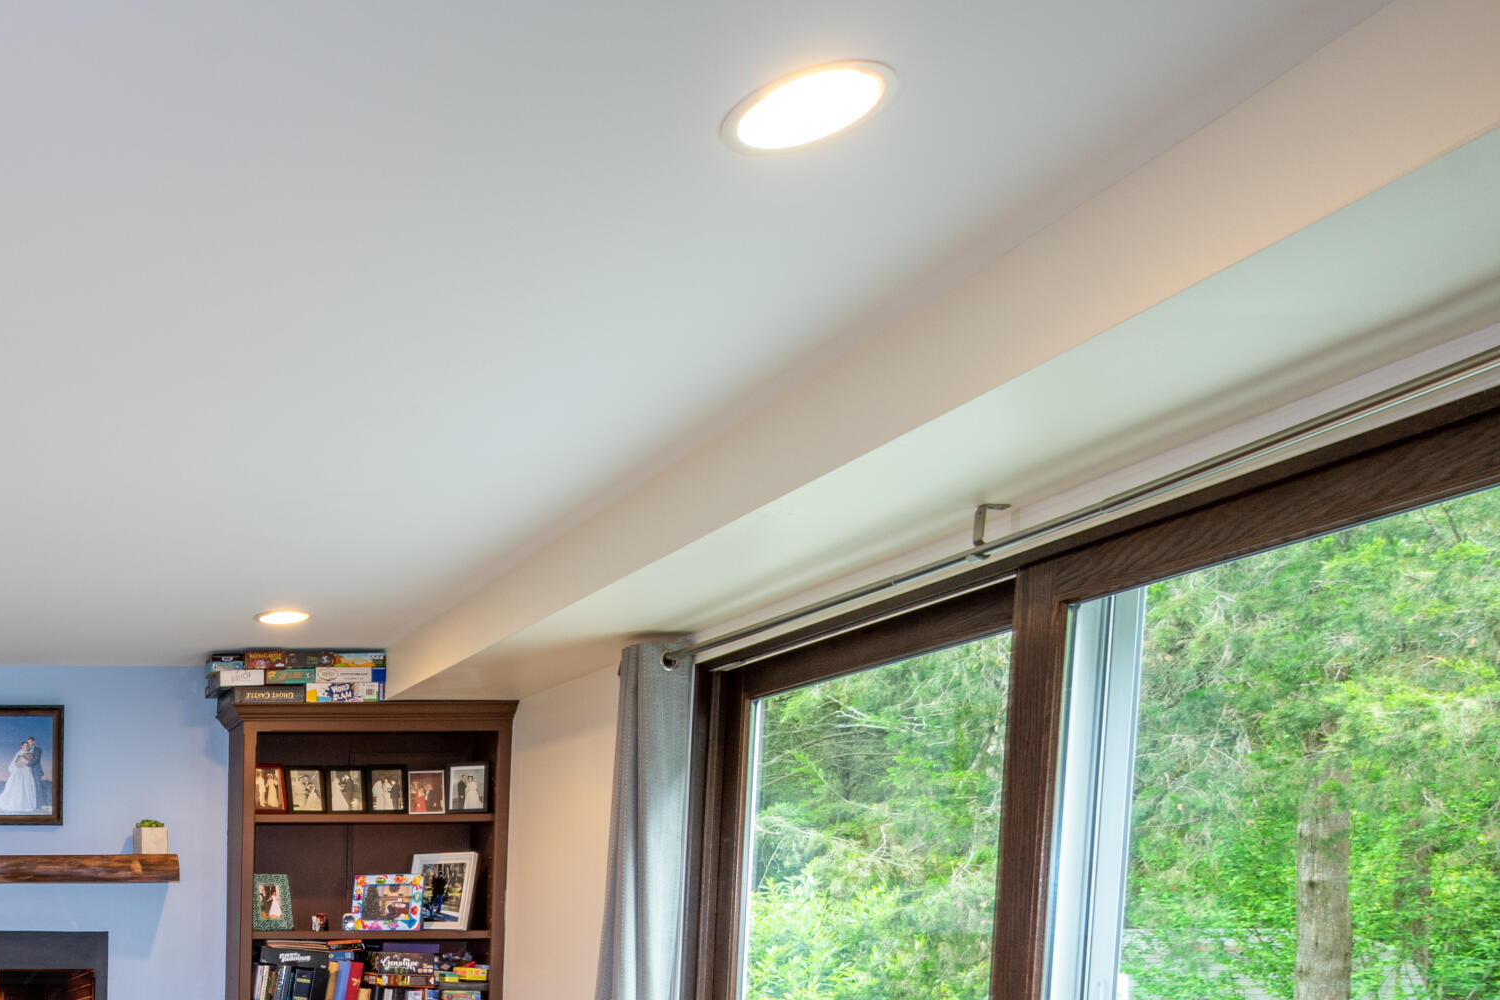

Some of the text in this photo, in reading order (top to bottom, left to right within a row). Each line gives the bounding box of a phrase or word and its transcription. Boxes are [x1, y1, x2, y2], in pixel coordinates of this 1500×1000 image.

[330, 683, 350, 693] WORD
[332, 690, 353, 701] SLAM
[380, 956, 419, 972] Genotype
